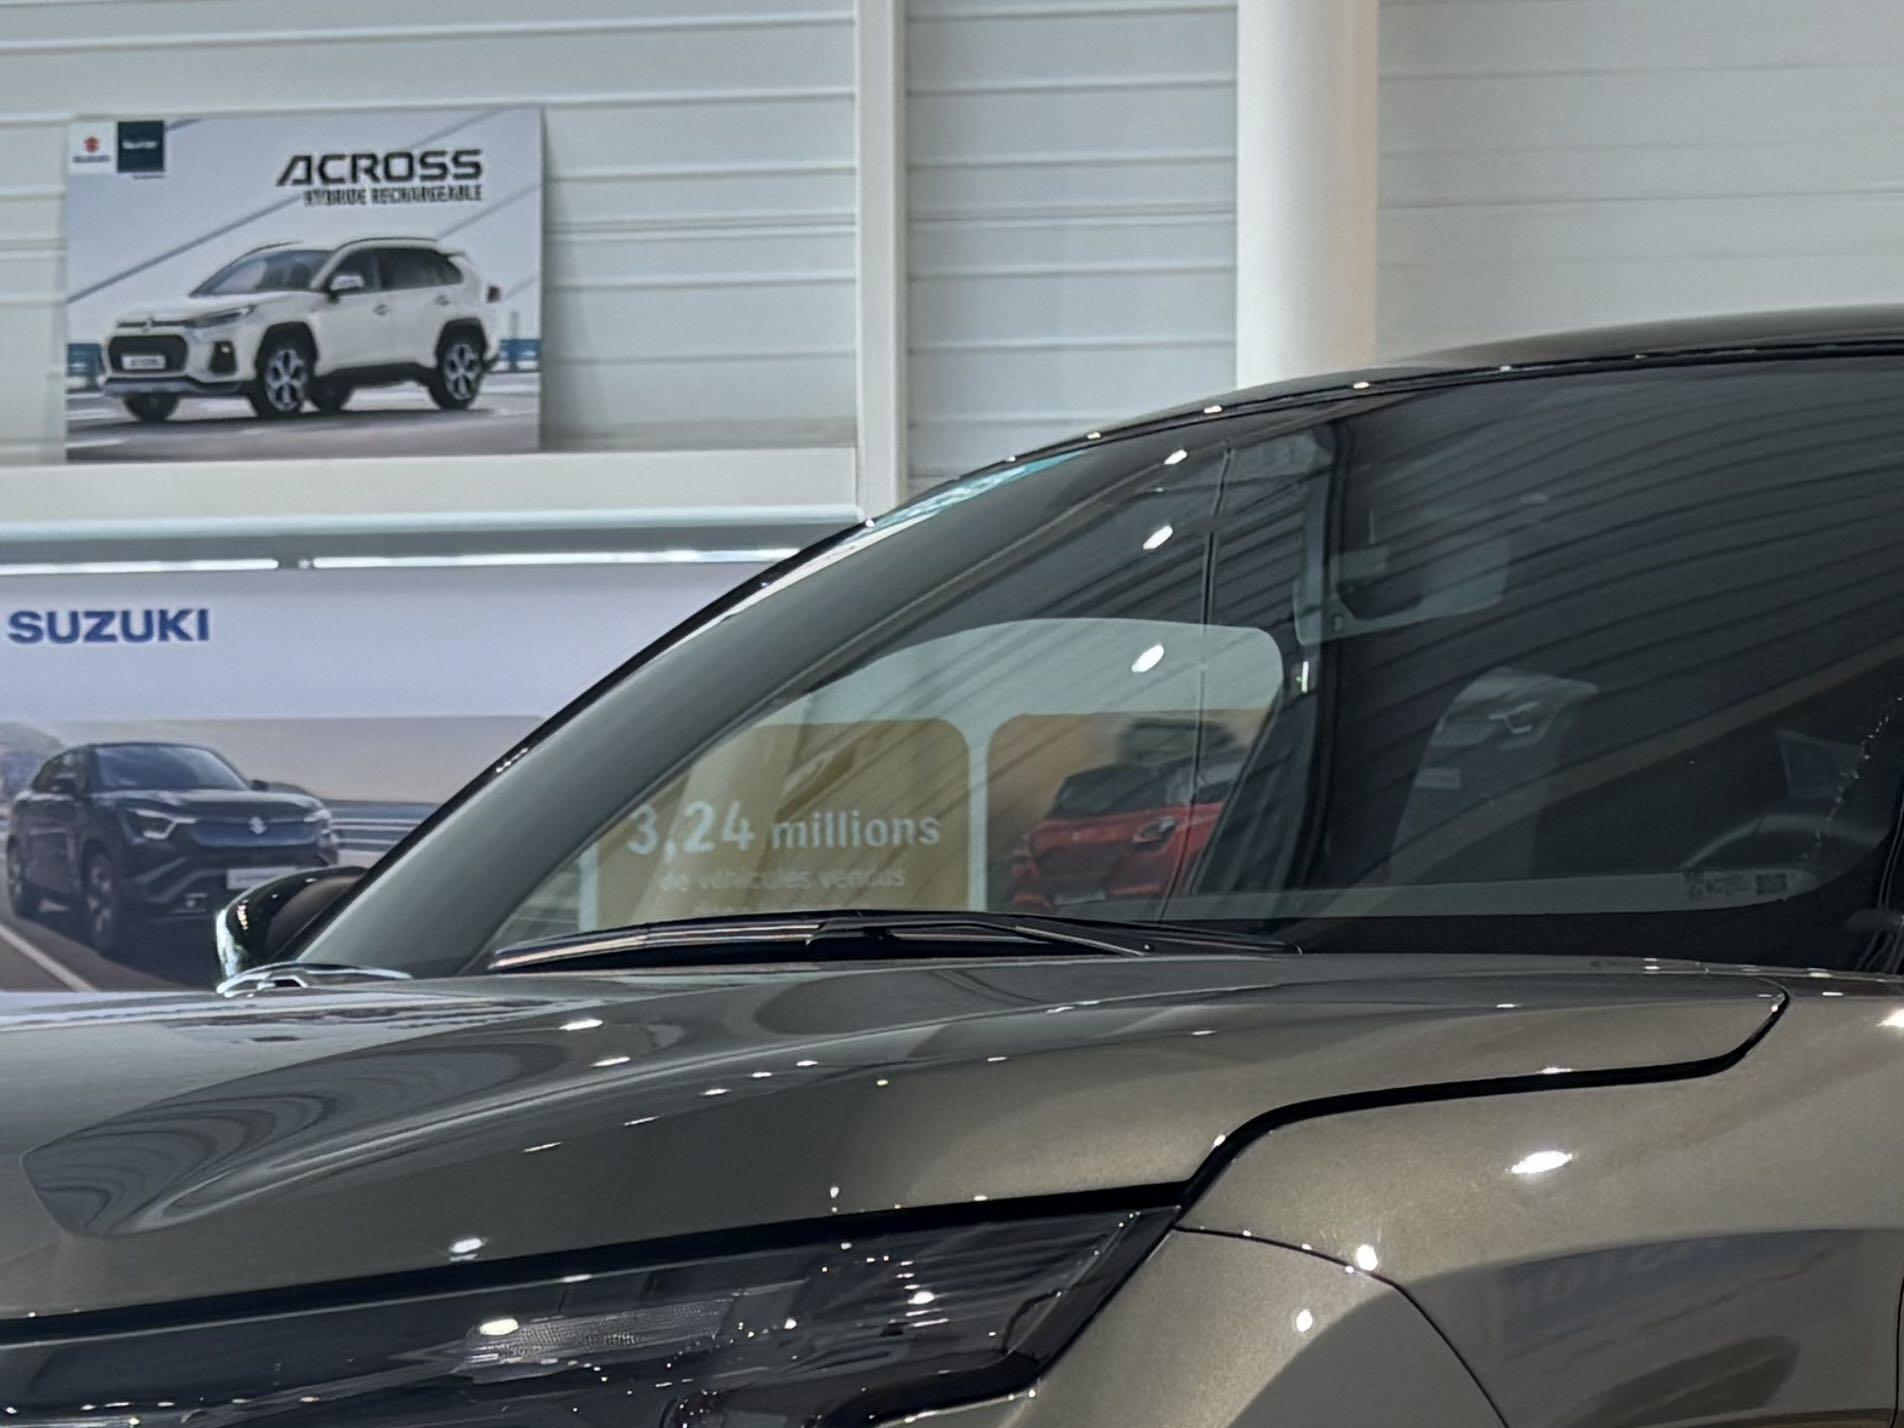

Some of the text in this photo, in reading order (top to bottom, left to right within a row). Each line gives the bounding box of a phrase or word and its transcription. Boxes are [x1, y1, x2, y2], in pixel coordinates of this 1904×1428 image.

[275, 148, 483, 187] ACROSS
[7, 608, 210, 645] SUZUKI
[627, 801, 941, 864] 3,24 millions
